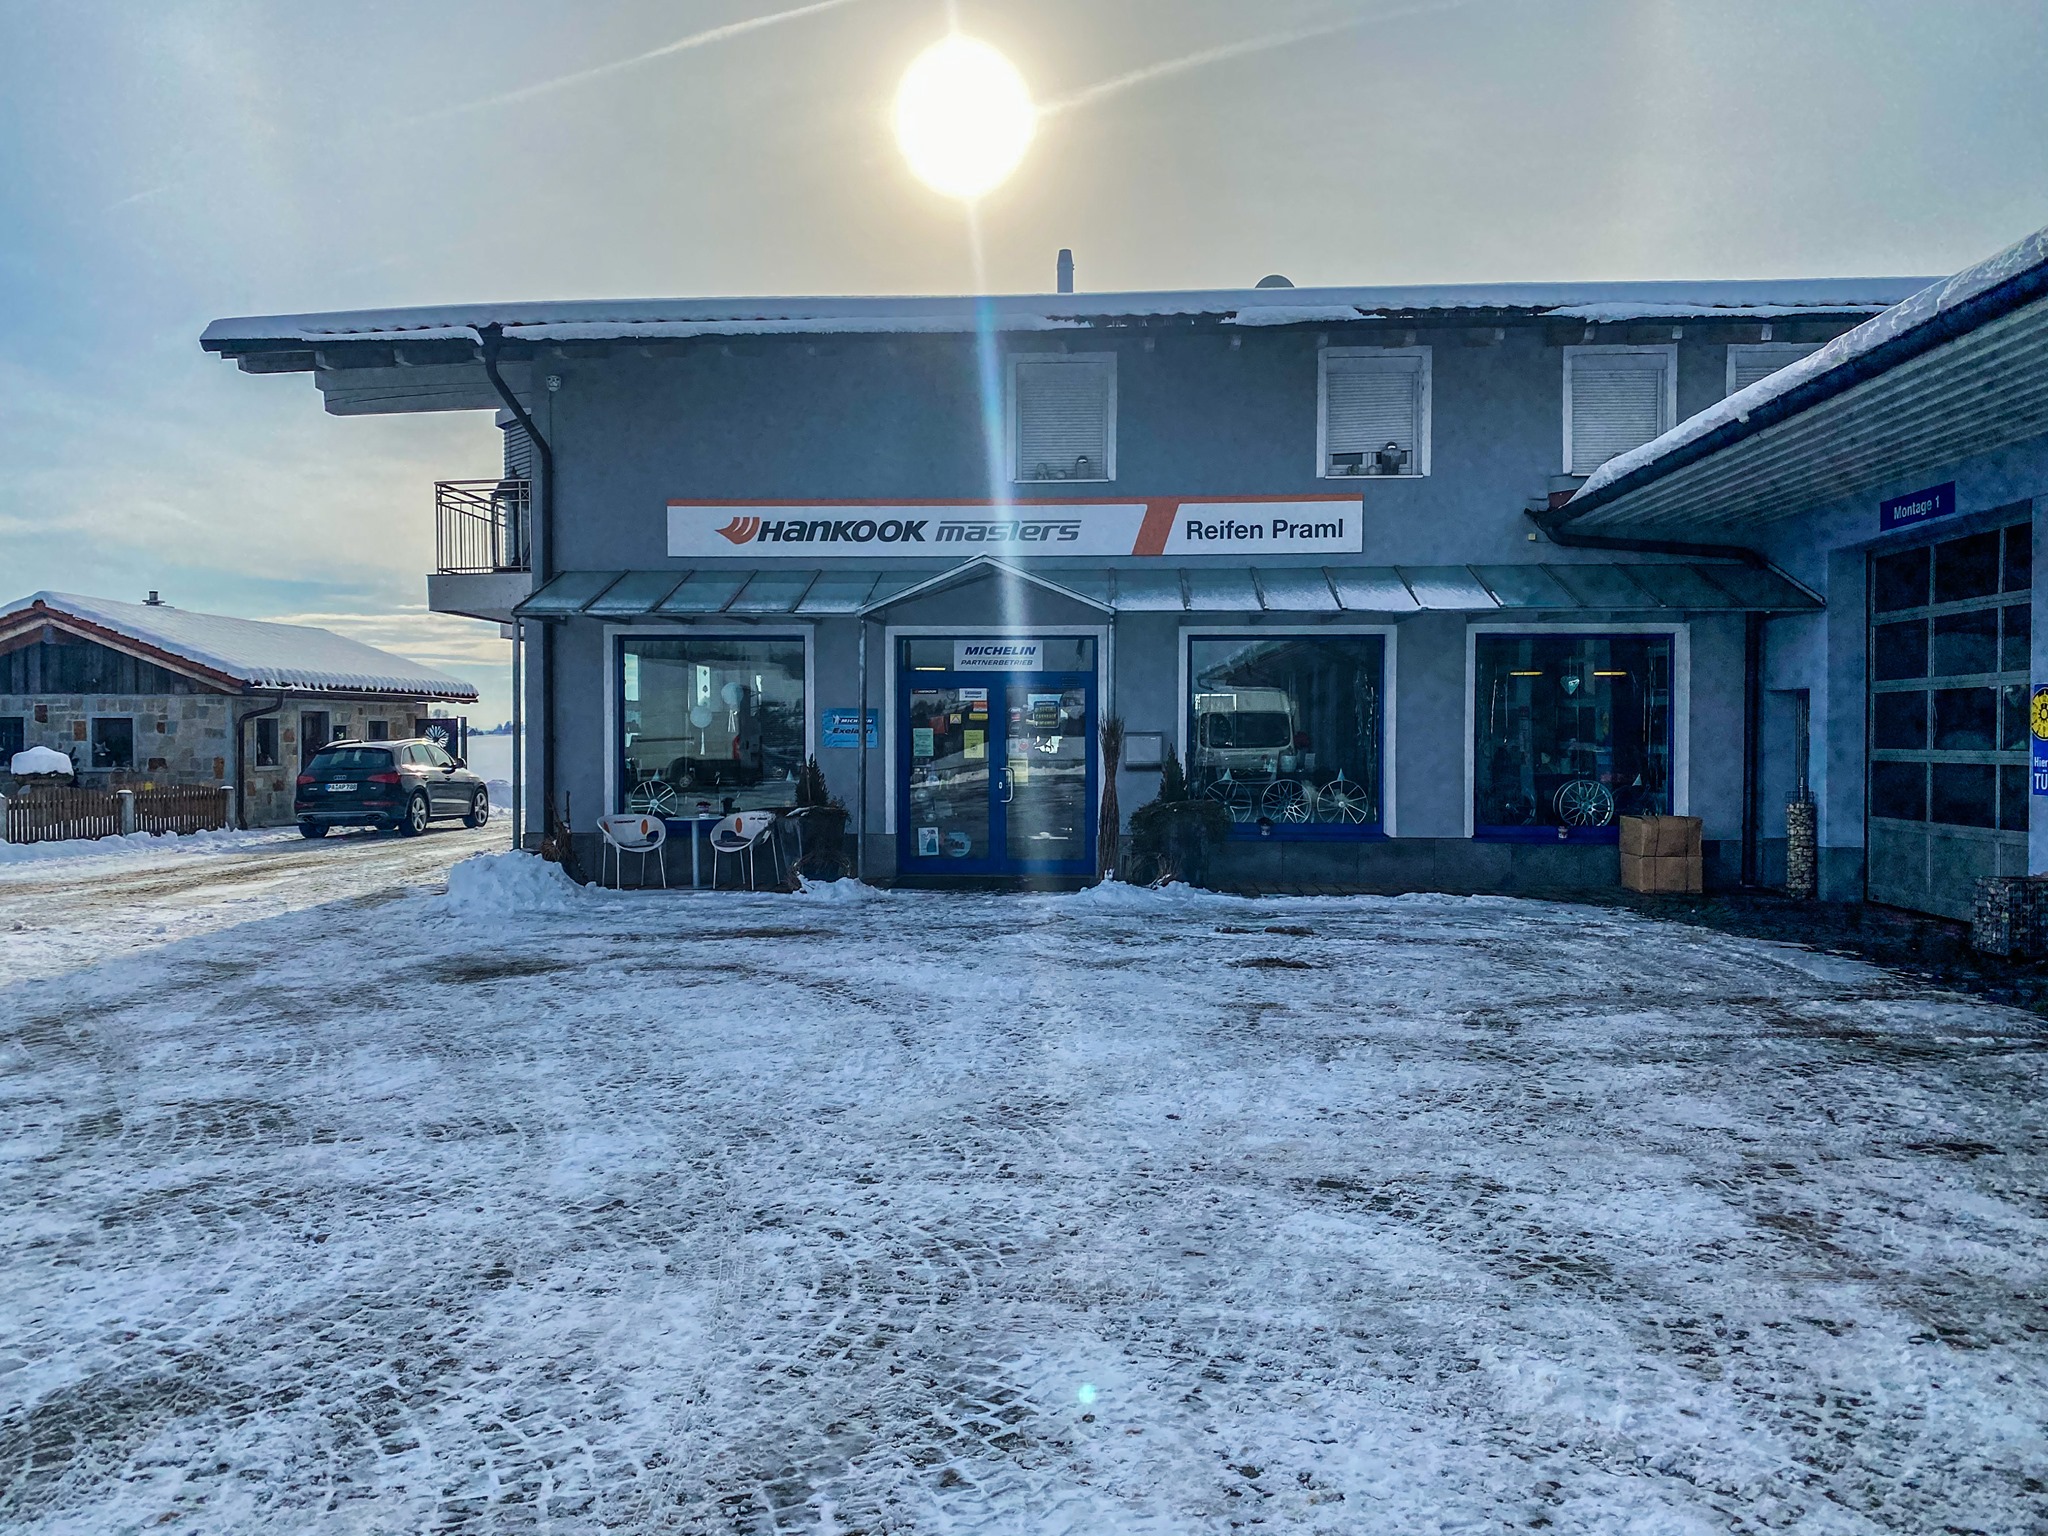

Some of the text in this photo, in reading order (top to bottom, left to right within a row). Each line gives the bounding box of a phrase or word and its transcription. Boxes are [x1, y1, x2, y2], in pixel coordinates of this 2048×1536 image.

[1893, 494, 1940, 520] Montage 1
[935, 519, 1082, 542] masters
[1186, 520, 1264, 540] Reifen
[1272, 518, 1344, 539] Praml
[964, 646, 1037, 656] MICHELIN
[2033, 756, 2048, 767] Hier
